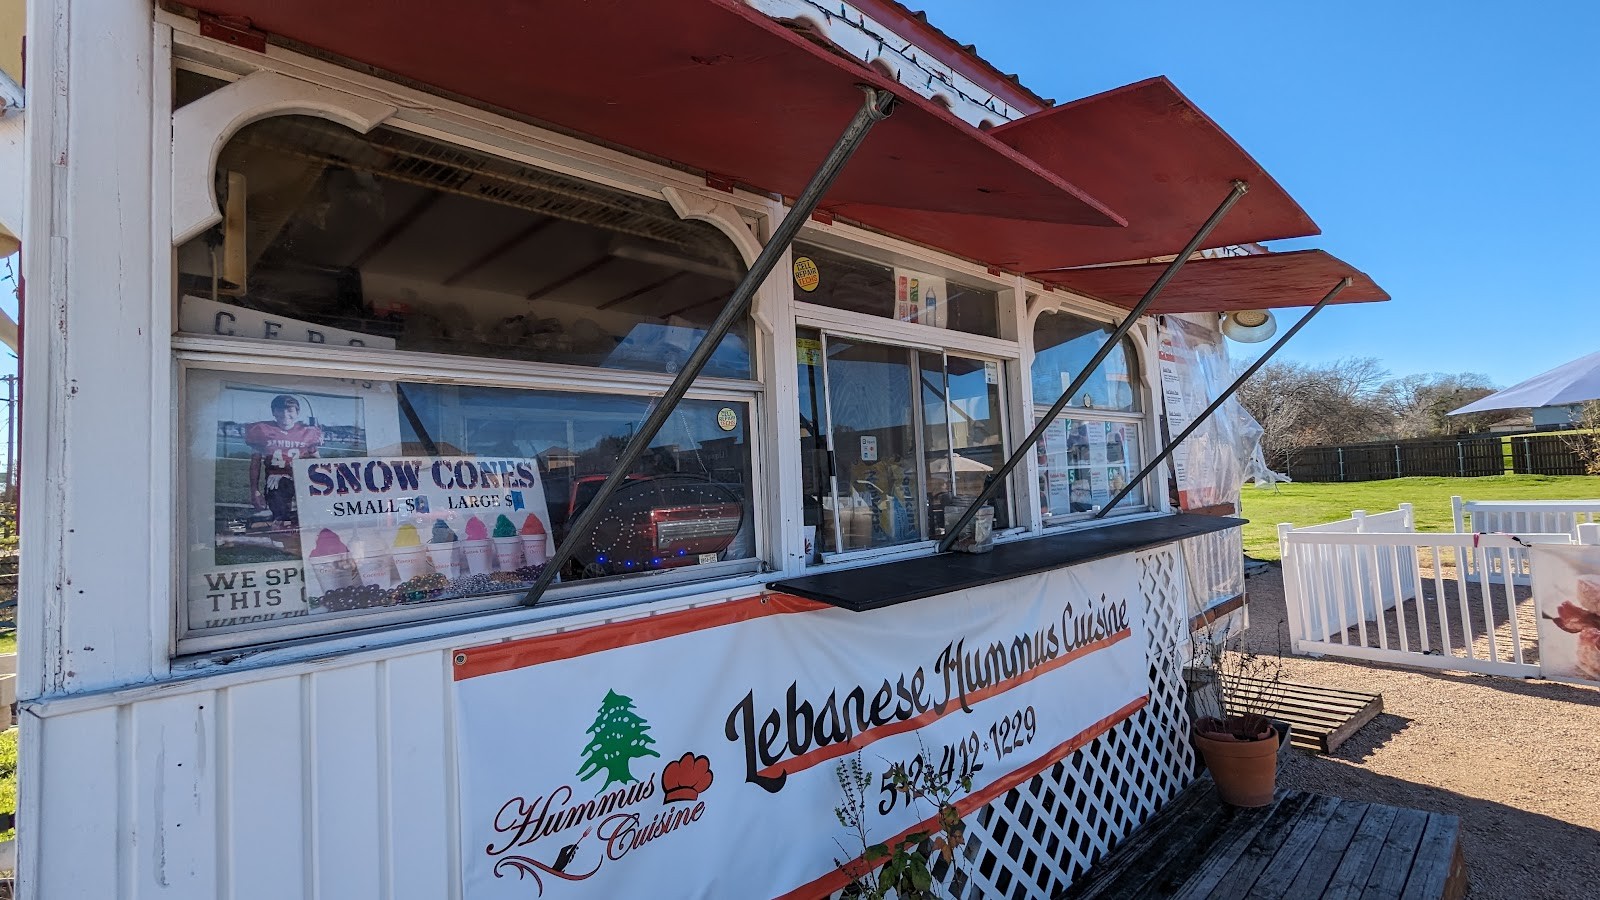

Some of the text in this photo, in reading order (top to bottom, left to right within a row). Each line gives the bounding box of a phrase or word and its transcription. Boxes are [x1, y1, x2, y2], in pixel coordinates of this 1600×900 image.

[795, 267, 817, 279] REPAIR
[798, 275, 818, 286] TECHS
[307, 459, 535, 496] SNOW CONES
[1069, 469, 1075, 483] 5
[333, 499, 400, 517] SMALL
[448, 494, 501, 510] LARGE
[203, 570, 256, 591] WE
[206, 588, 282, 612] THIS
[725, 594, 1130, 794] Lebanese Hummus Cuisine
[486, 772, 656, 856] Hummus
[597, 801, 706, 861] Cuisine
